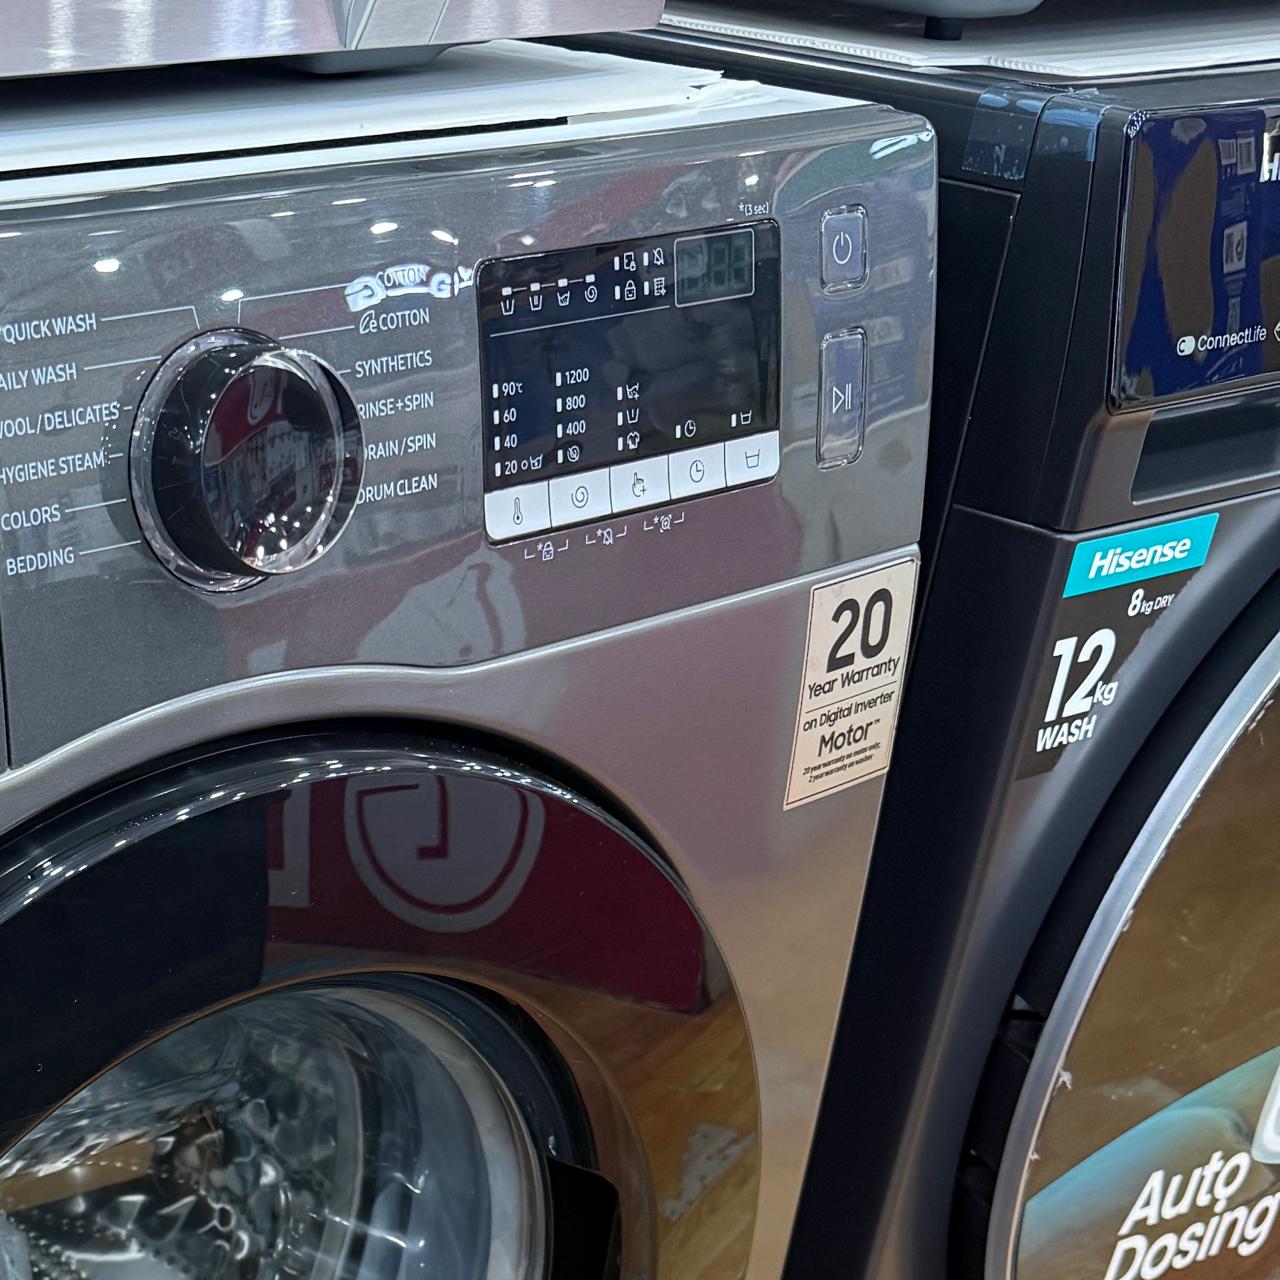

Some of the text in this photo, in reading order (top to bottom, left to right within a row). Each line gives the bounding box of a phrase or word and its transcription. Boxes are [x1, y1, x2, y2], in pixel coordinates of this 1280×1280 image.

[3, 319, 52, 344] QUICK
[52, 313, 97, 336] WASH
[1198, 325, 1267, 351] ConnectLife
[32, 362, 77, 386] WASH
[355, 350, 433, 378] SYNTHETICS
[565, 368, 589, 384] 1200
[566, 394, 586, 410] 800
[503, 408, 517, 423] 60
[566, 420, 586, 435] 400
[504, 434, 518, 448] 40
[59, 450, 105, 475] STEAM
[505, 460, 518, 475] 20
[397, 473, 438, 496] CLEAN
[1, 504, 61, 531] COLORS
[6, 547, 75, 575] BEDDING
[1088, 537, 1192, 579] Hisense
[1154, 593, 1176, 610] DRY
[826, 588, 893, 673] 20
[808, 656, 900, 700] Year Warranty
[803, 691, 895, 732] on Digital Inverter
[1036, 715, 1098, 752] WASH
[1117, 1150, 1251, 1236] Auto
